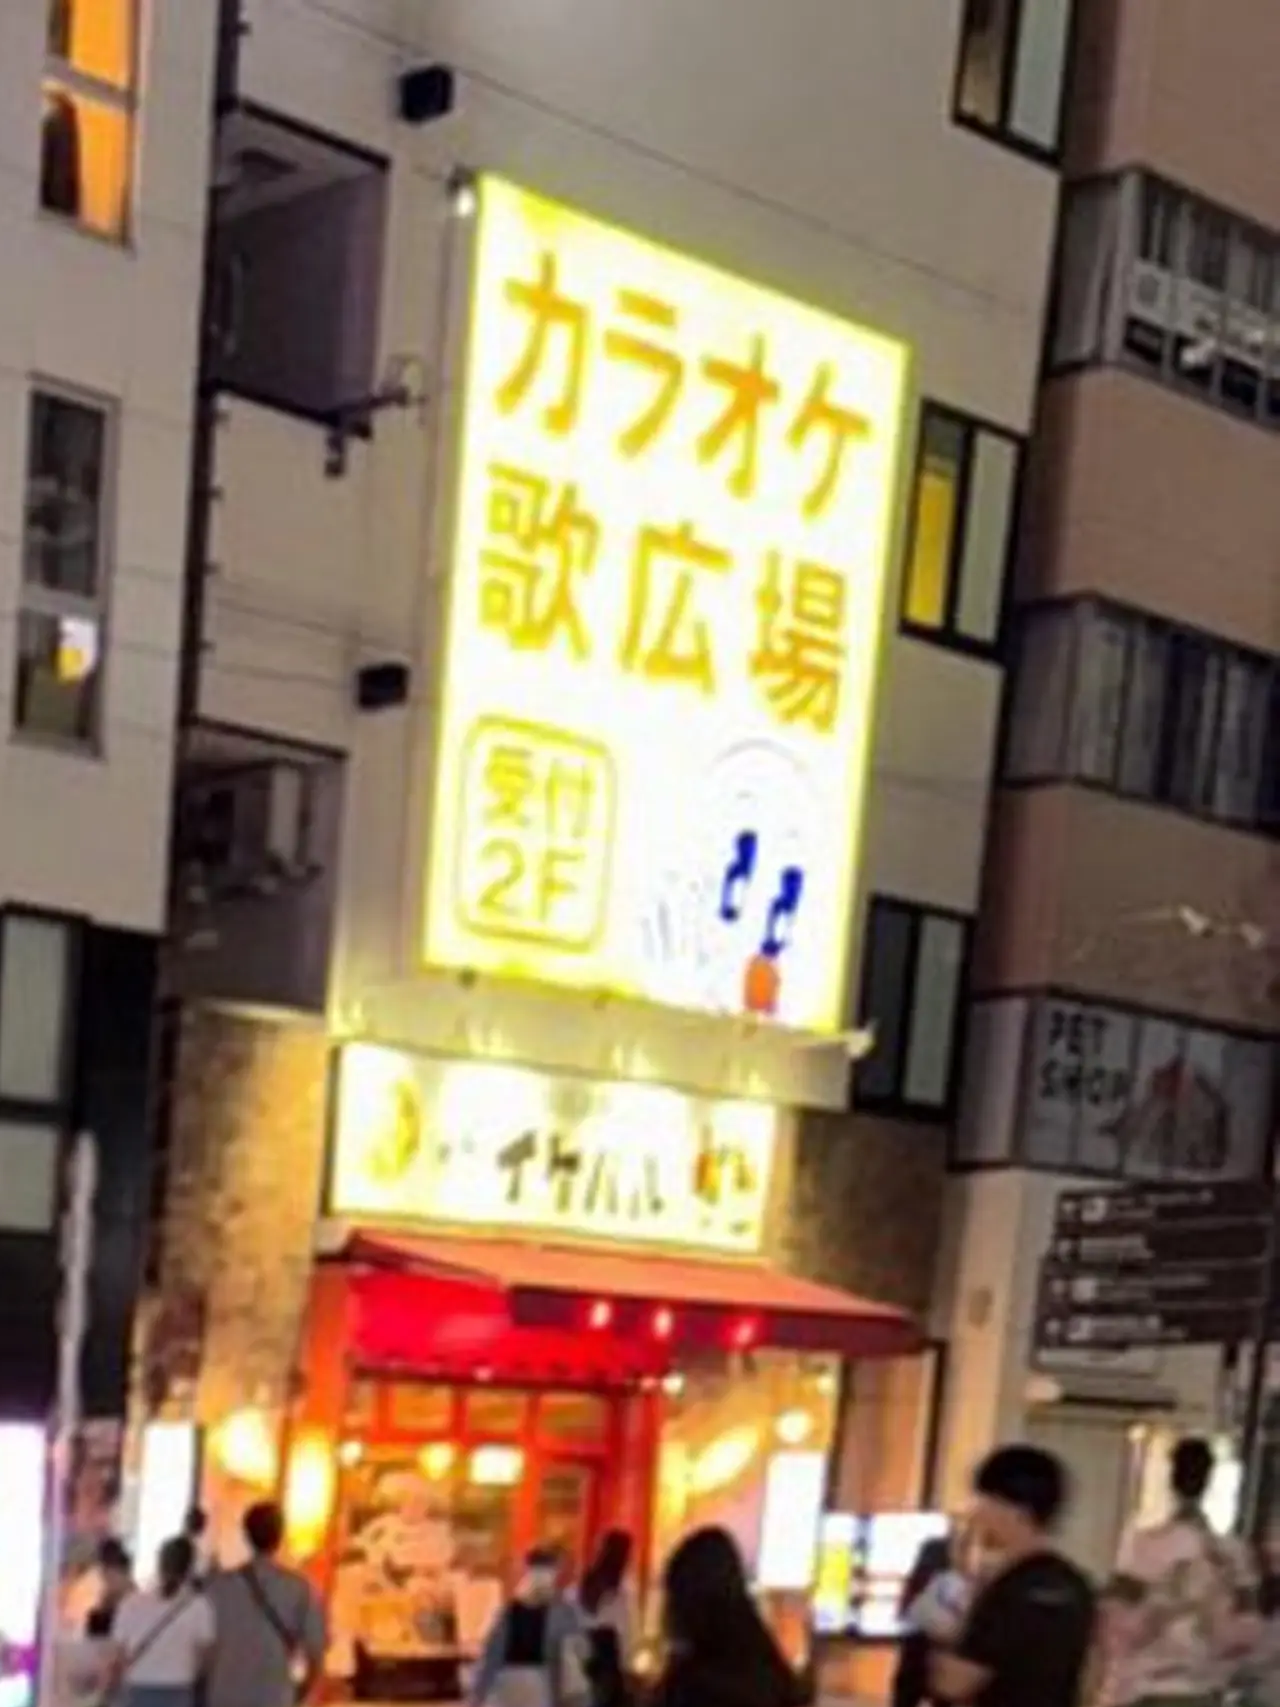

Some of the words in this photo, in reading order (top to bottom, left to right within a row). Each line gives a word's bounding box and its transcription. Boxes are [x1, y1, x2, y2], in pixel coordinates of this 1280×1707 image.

[495, 252, 872, 522] カラオケ
[478, 460, 848, 734] 歌広場
[478, 837, 586, 922] 2F
[483, 745, 591, 838] 受付
